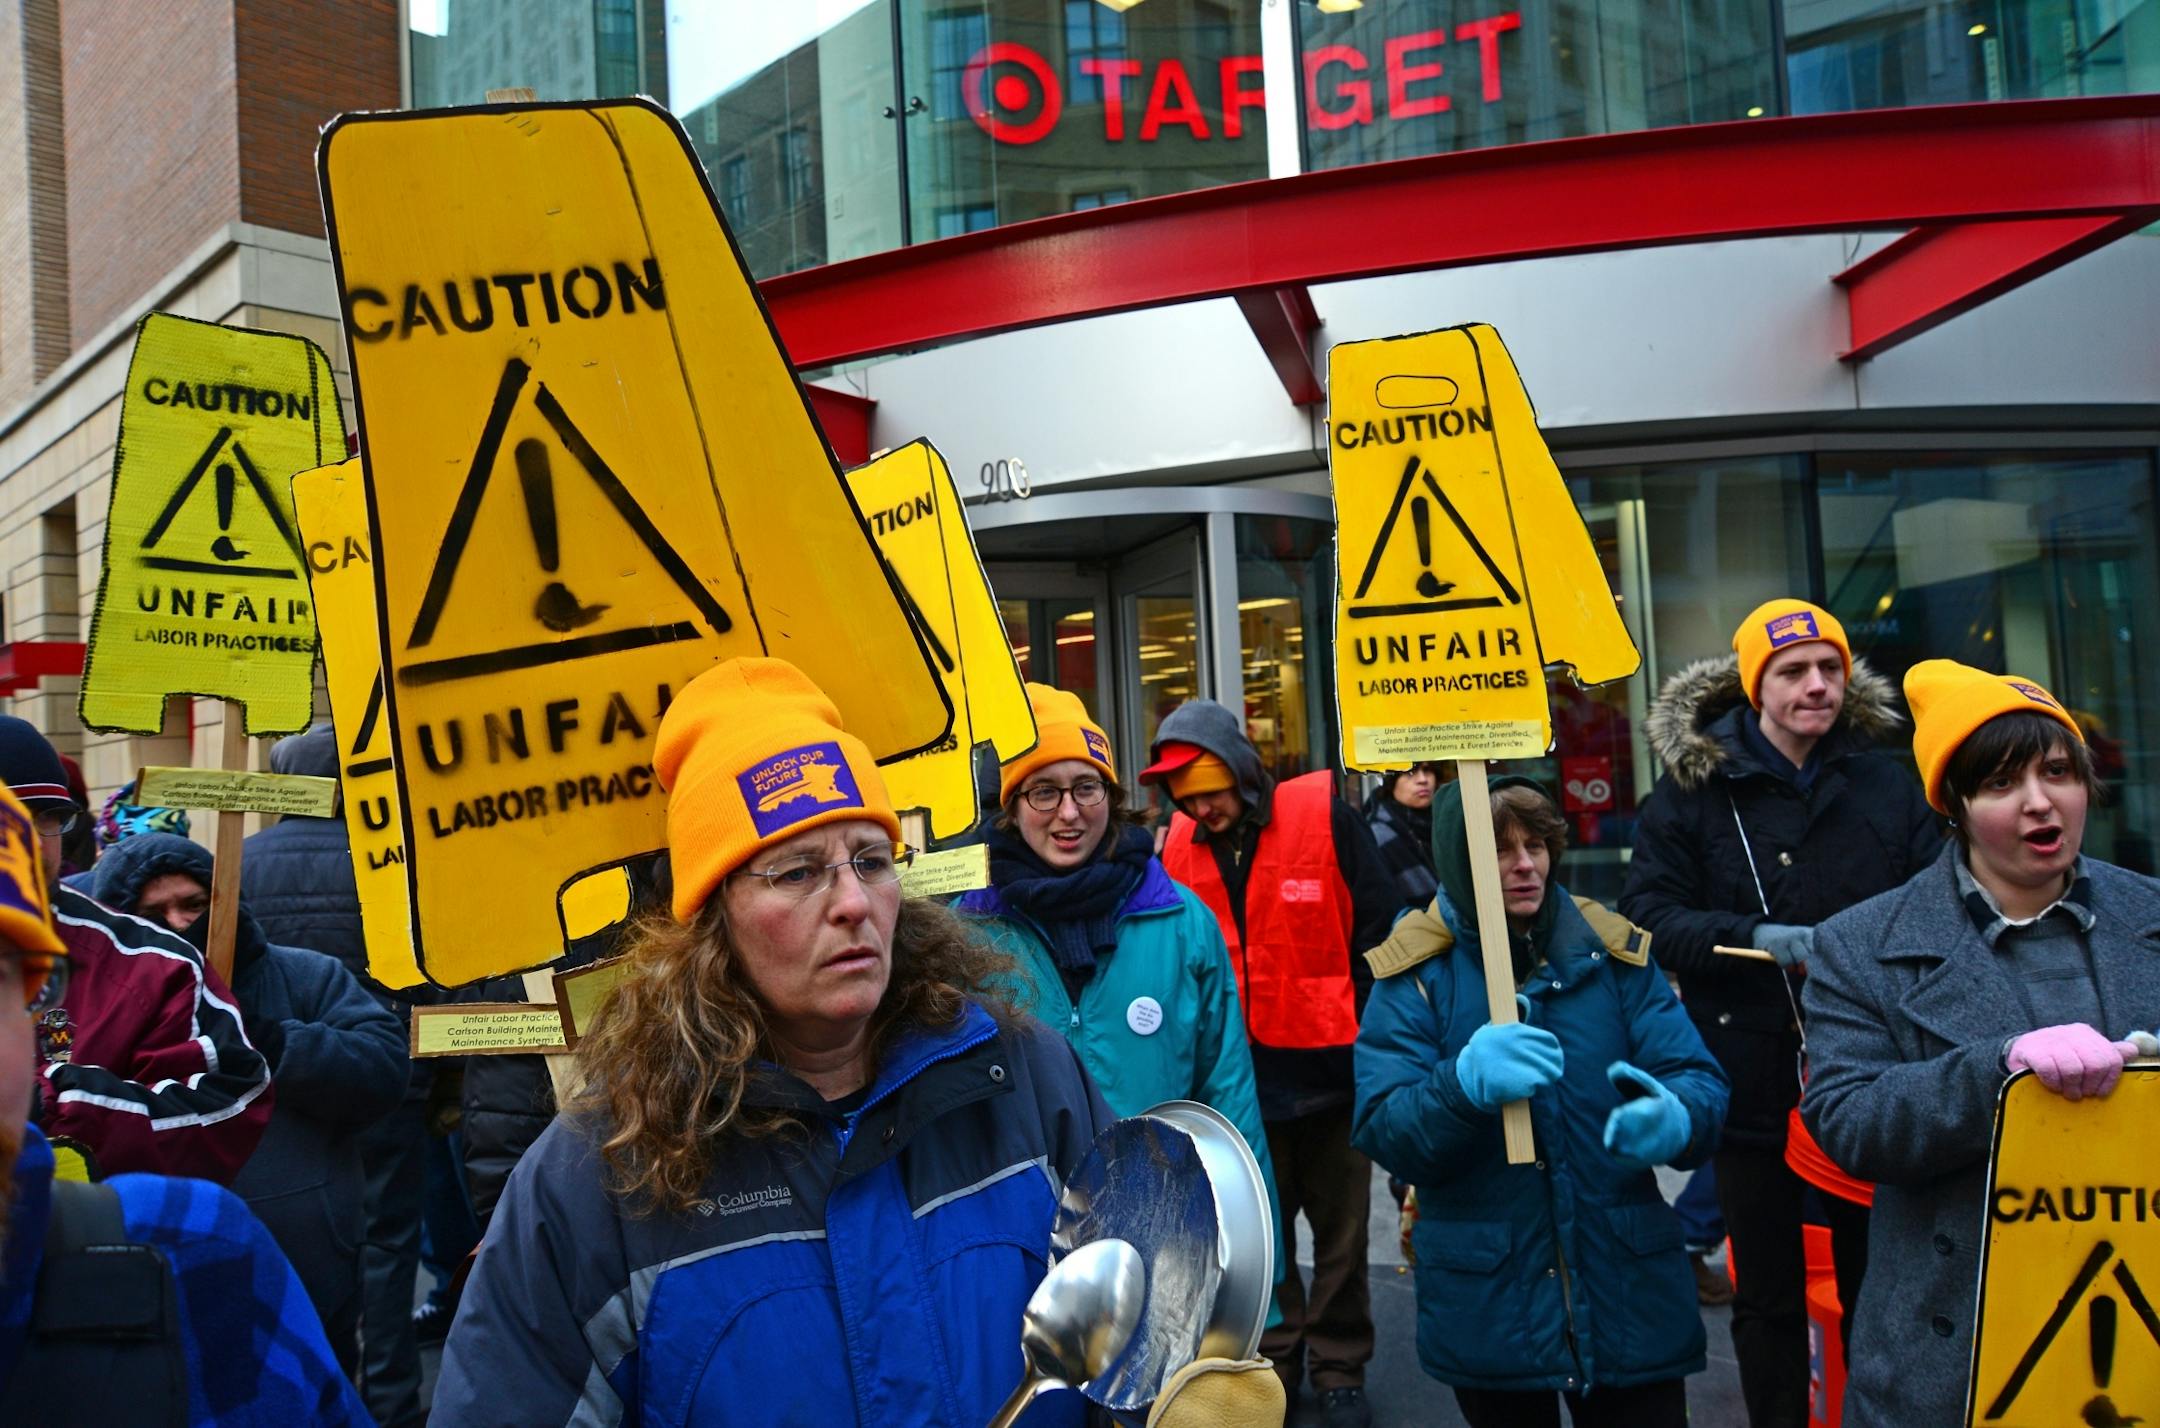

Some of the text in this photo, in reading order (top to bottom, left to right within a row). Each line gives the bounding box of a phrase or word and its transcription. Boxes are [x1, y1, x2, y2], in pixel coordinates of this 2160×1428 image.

[1080, 12, 1522, 141] TARGET
[349, 258, 667, 343] CAUTION
[143, 378, 311, 420] CAUTION
[1335, 405, 1493, 450] CAUTION
[980, 457, 1031, 505] 900
[137, 585, 309, 624] UNFAIR
[135, 628, 317, 653] LABOR PRACTICES
[1355, 628, 1521, 666] UNFAIR
[1359, 669, 1529, 697] LABOR PRACTICES
[417, 683, 675, 775] UNFAI
[1374, 737, 1403, 745] Carlson
[1405, 735, 1433, 743] Building
[1384, 727, 1406, 735] Unfair
[1430, 724, 1460, 732] Practice
[1463, 722, 1482, 730] Strike
[1485, 721, 1513, 730] Against
[1378, 740, 1523, 754] Maintenance Systems & Eurest Services
[752, 750, 824, 784] UNLOCK OUR
[755, 768, 799, 792] FUTURE
[428, 785, 548, 838] LABOR
[447, 1027, 484, 1036] Carlson
[487, 1026, 524, 1035] Building
[462, 1013, 559, 1024] Unfair Labor Practice
[451, 1036, 564, 1047] Maintenance Systems &
[717, 1184, 792, 1208] Columbia
[719, 1197, 793, 1216] Sportswear Company
[1991, 1186, 2160, 1224] CAUTI
